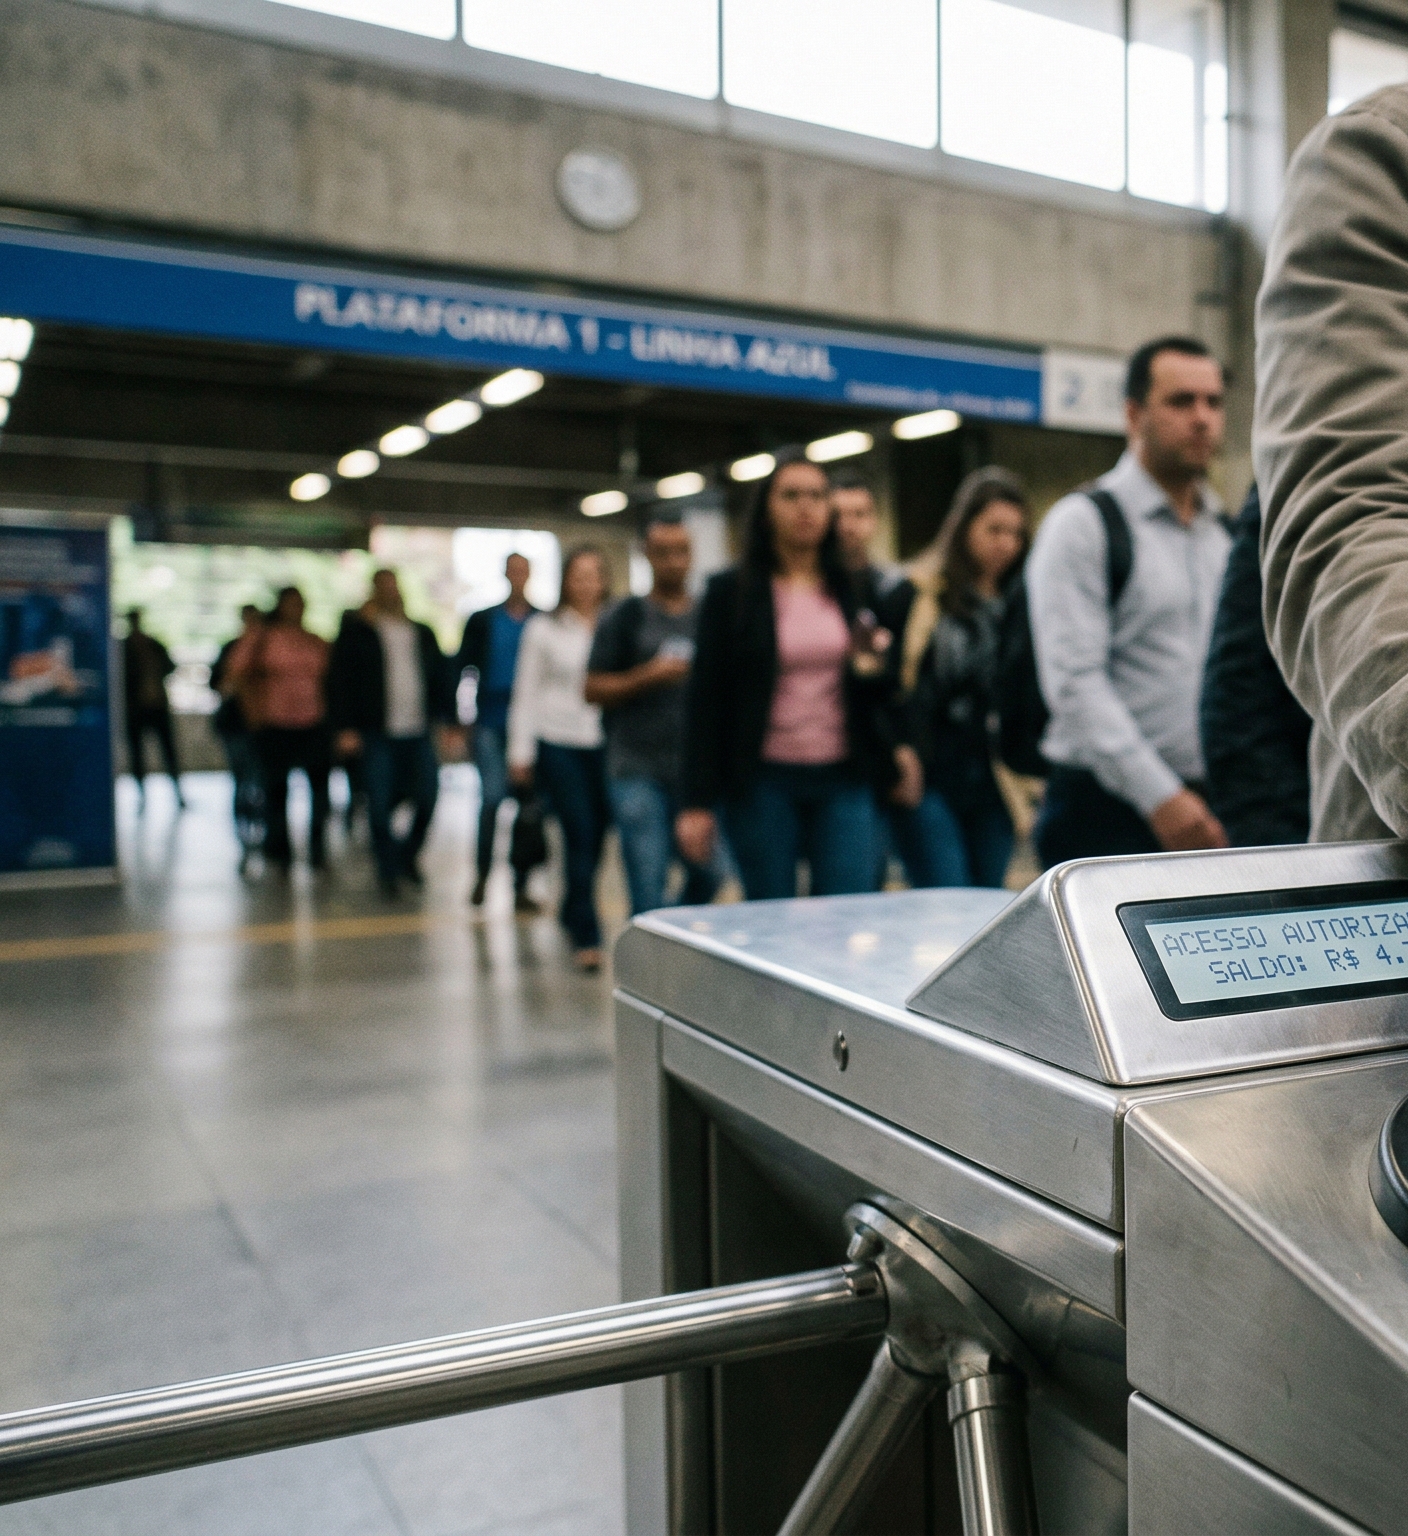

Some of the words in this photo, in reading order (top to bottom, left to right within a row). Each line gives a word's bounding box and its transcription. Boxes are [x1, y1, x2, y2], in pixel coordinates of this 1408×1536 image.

[294, 283, 572, 353] PLATAFORMA
[577, 316, 599, 354] 1
[1162, 926, 1268, 958] ACESSO
[1209, 954, 1308, 984] SALDO:
[1324, 947, 1361, 972] R$
